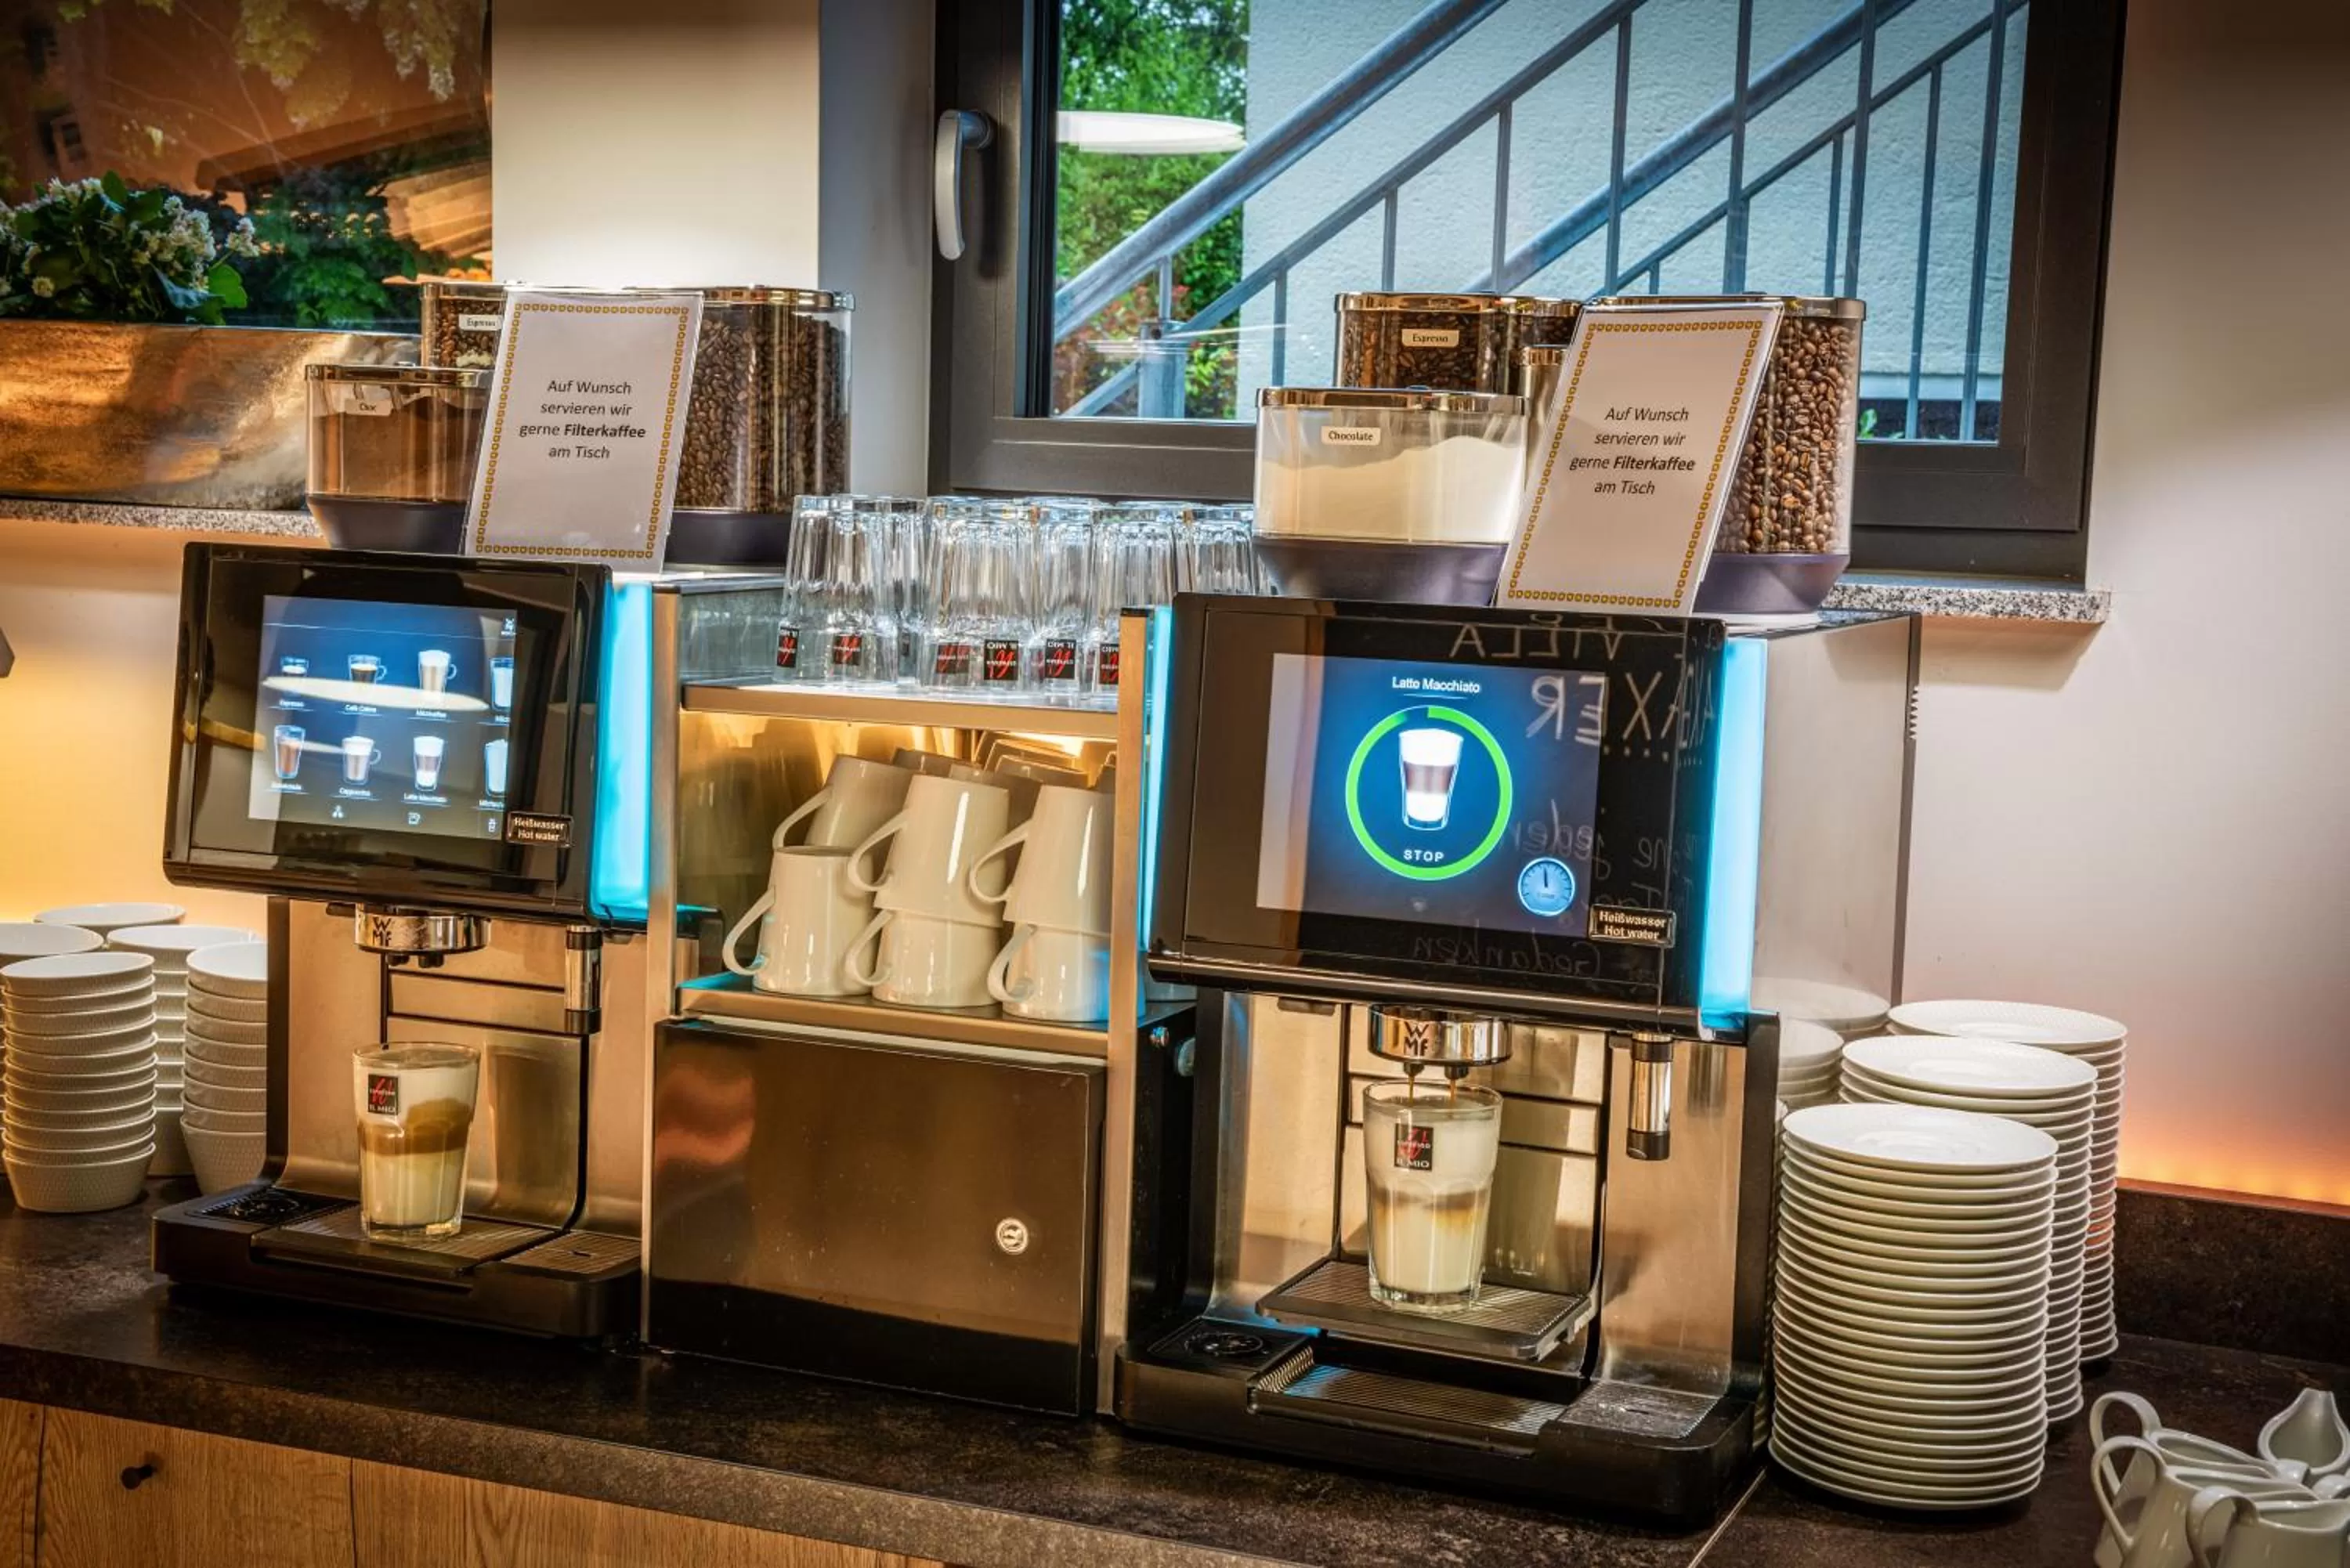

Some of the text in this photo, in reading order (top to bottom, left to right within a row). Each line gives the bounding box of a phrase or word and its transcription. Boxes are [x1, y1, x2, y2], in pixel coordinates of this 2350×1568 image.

[1412, 334, 1448, 344] Espresso
[548, 380, 631, 394] Auf Wunsch
[540, 403, 632, 416] servieren wir
[1605, 406, 1689, 421] Auf Wunsch
[519, 424, 646, 438] gerne Filterkaffee
[1328, 431, 1373, 442] Chocolate
[1594, 432, 1686, 446] servieren wir
[548, 445, 610, 459] am Tisch
[1569, 455, 1696, 471] gerne Filterkaffee
[1594, 480, 1655, 495] am Tisch
[1423, 677, 1481, 693] Macchiato
[514, 817, 565, 830] Heißwasser
[518, 829, 560, 841] Hot water
[1404, 850, 1444, 862] STOP
[1599, 910, 1666, 927] Heißwasser
[1604, 925, 1660, 940] Hot water
